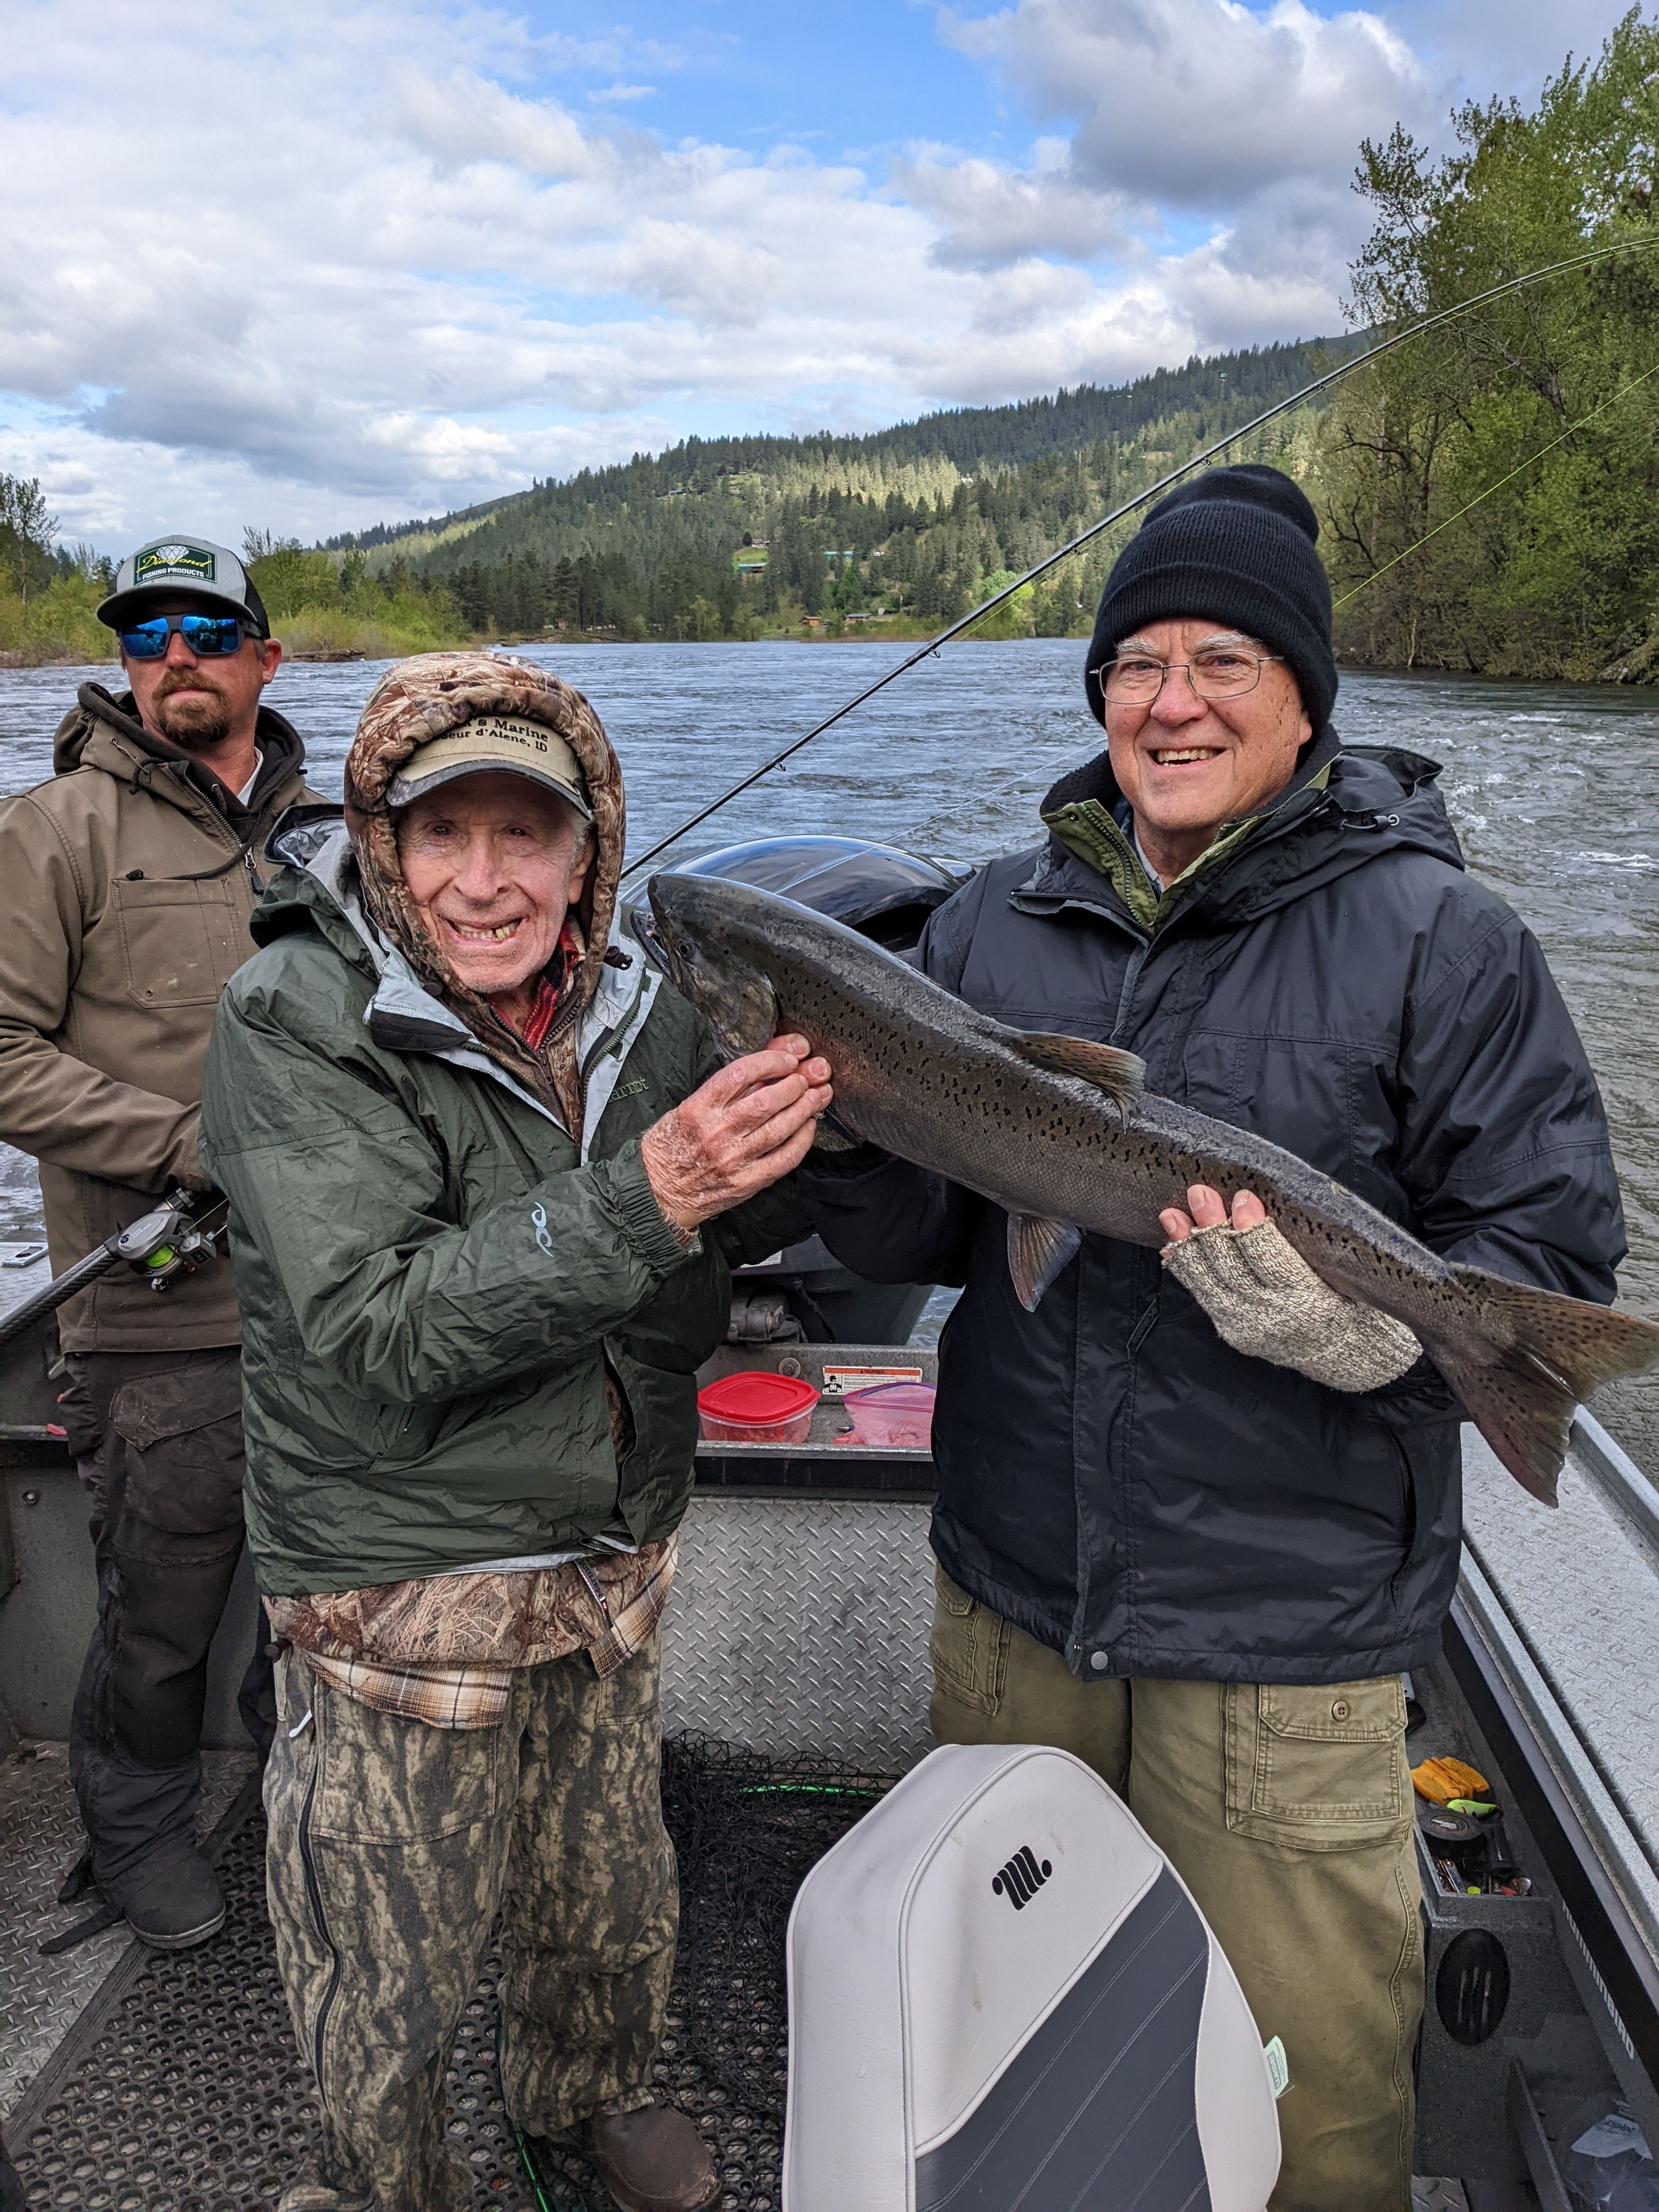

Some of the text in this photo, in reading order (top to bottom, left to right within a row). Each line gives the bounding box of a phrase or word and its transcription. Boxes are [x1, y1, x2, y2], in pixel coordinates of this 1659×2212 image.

[136, 554, 212, 573] Diamond
[143, 568, 204, 580] FISHING PRODUCTS
[437, 728, 547, 752] oeur d'Alene, ID
[494, 718, 548, 742] Marine
[608, 1077, 649, 1103] armot
